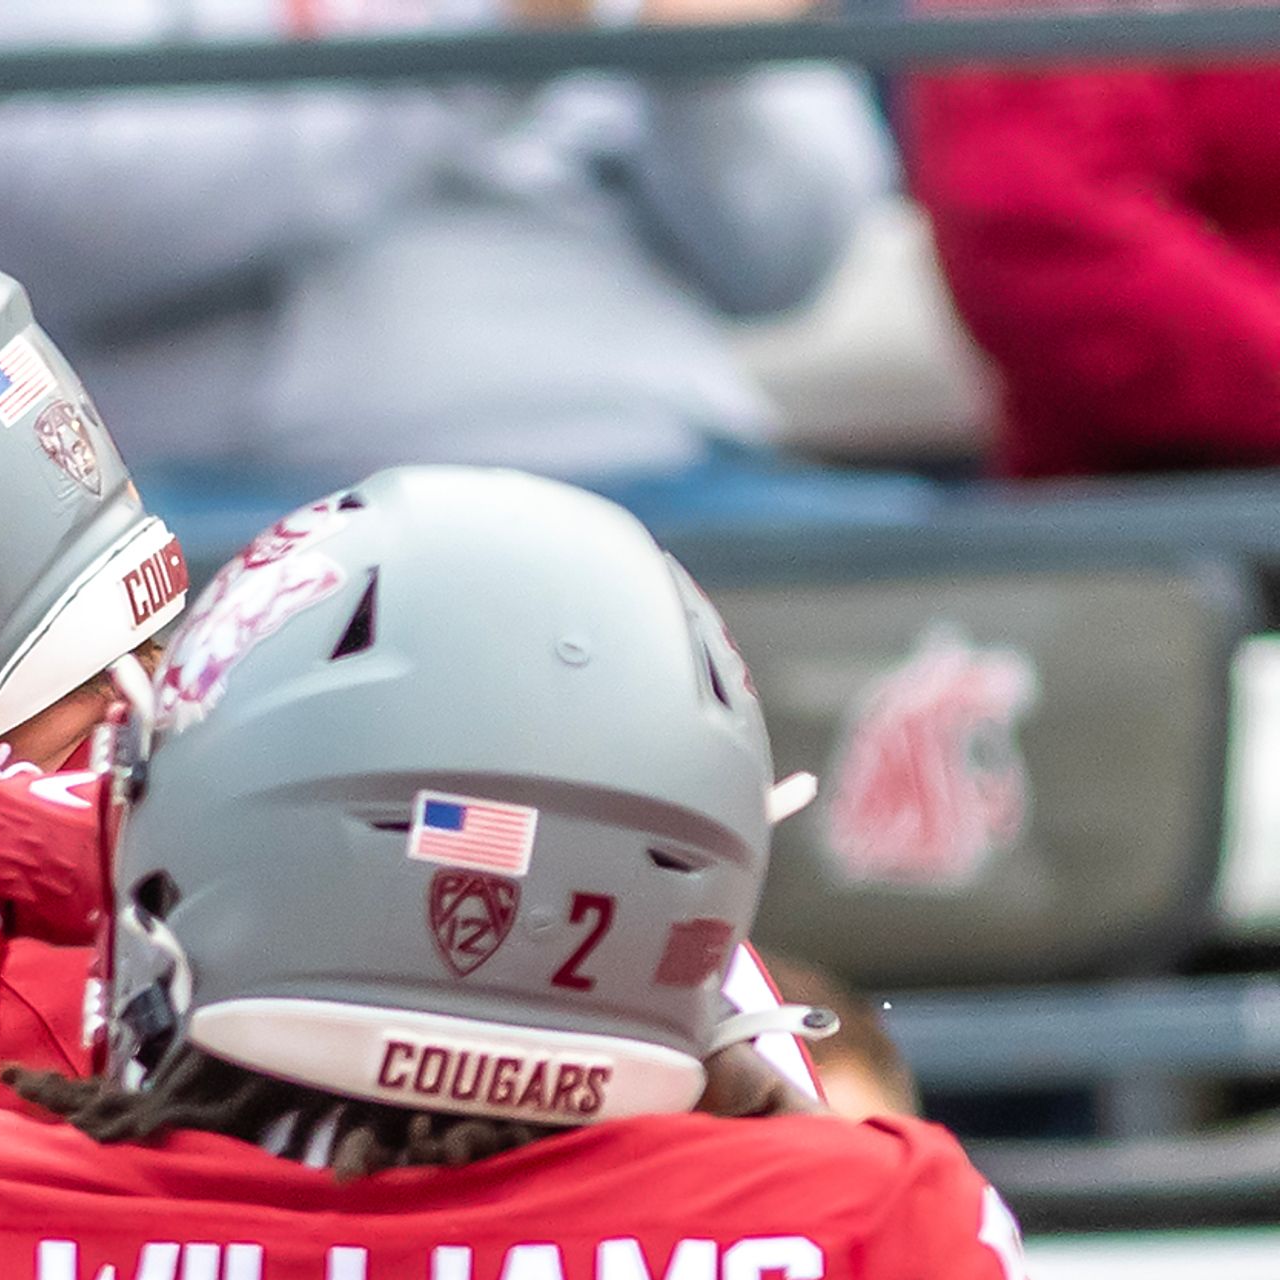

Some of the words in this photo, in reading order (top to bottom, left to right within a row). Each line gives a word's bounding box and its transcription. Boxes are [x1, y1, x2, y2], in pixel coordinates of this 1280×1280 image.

[122, 536, 188, 628] COU
[448, 916, 492, 957] 12
[550, 890, 617, 992] 2
[377, 1040, 612, 1114] COUGARS
